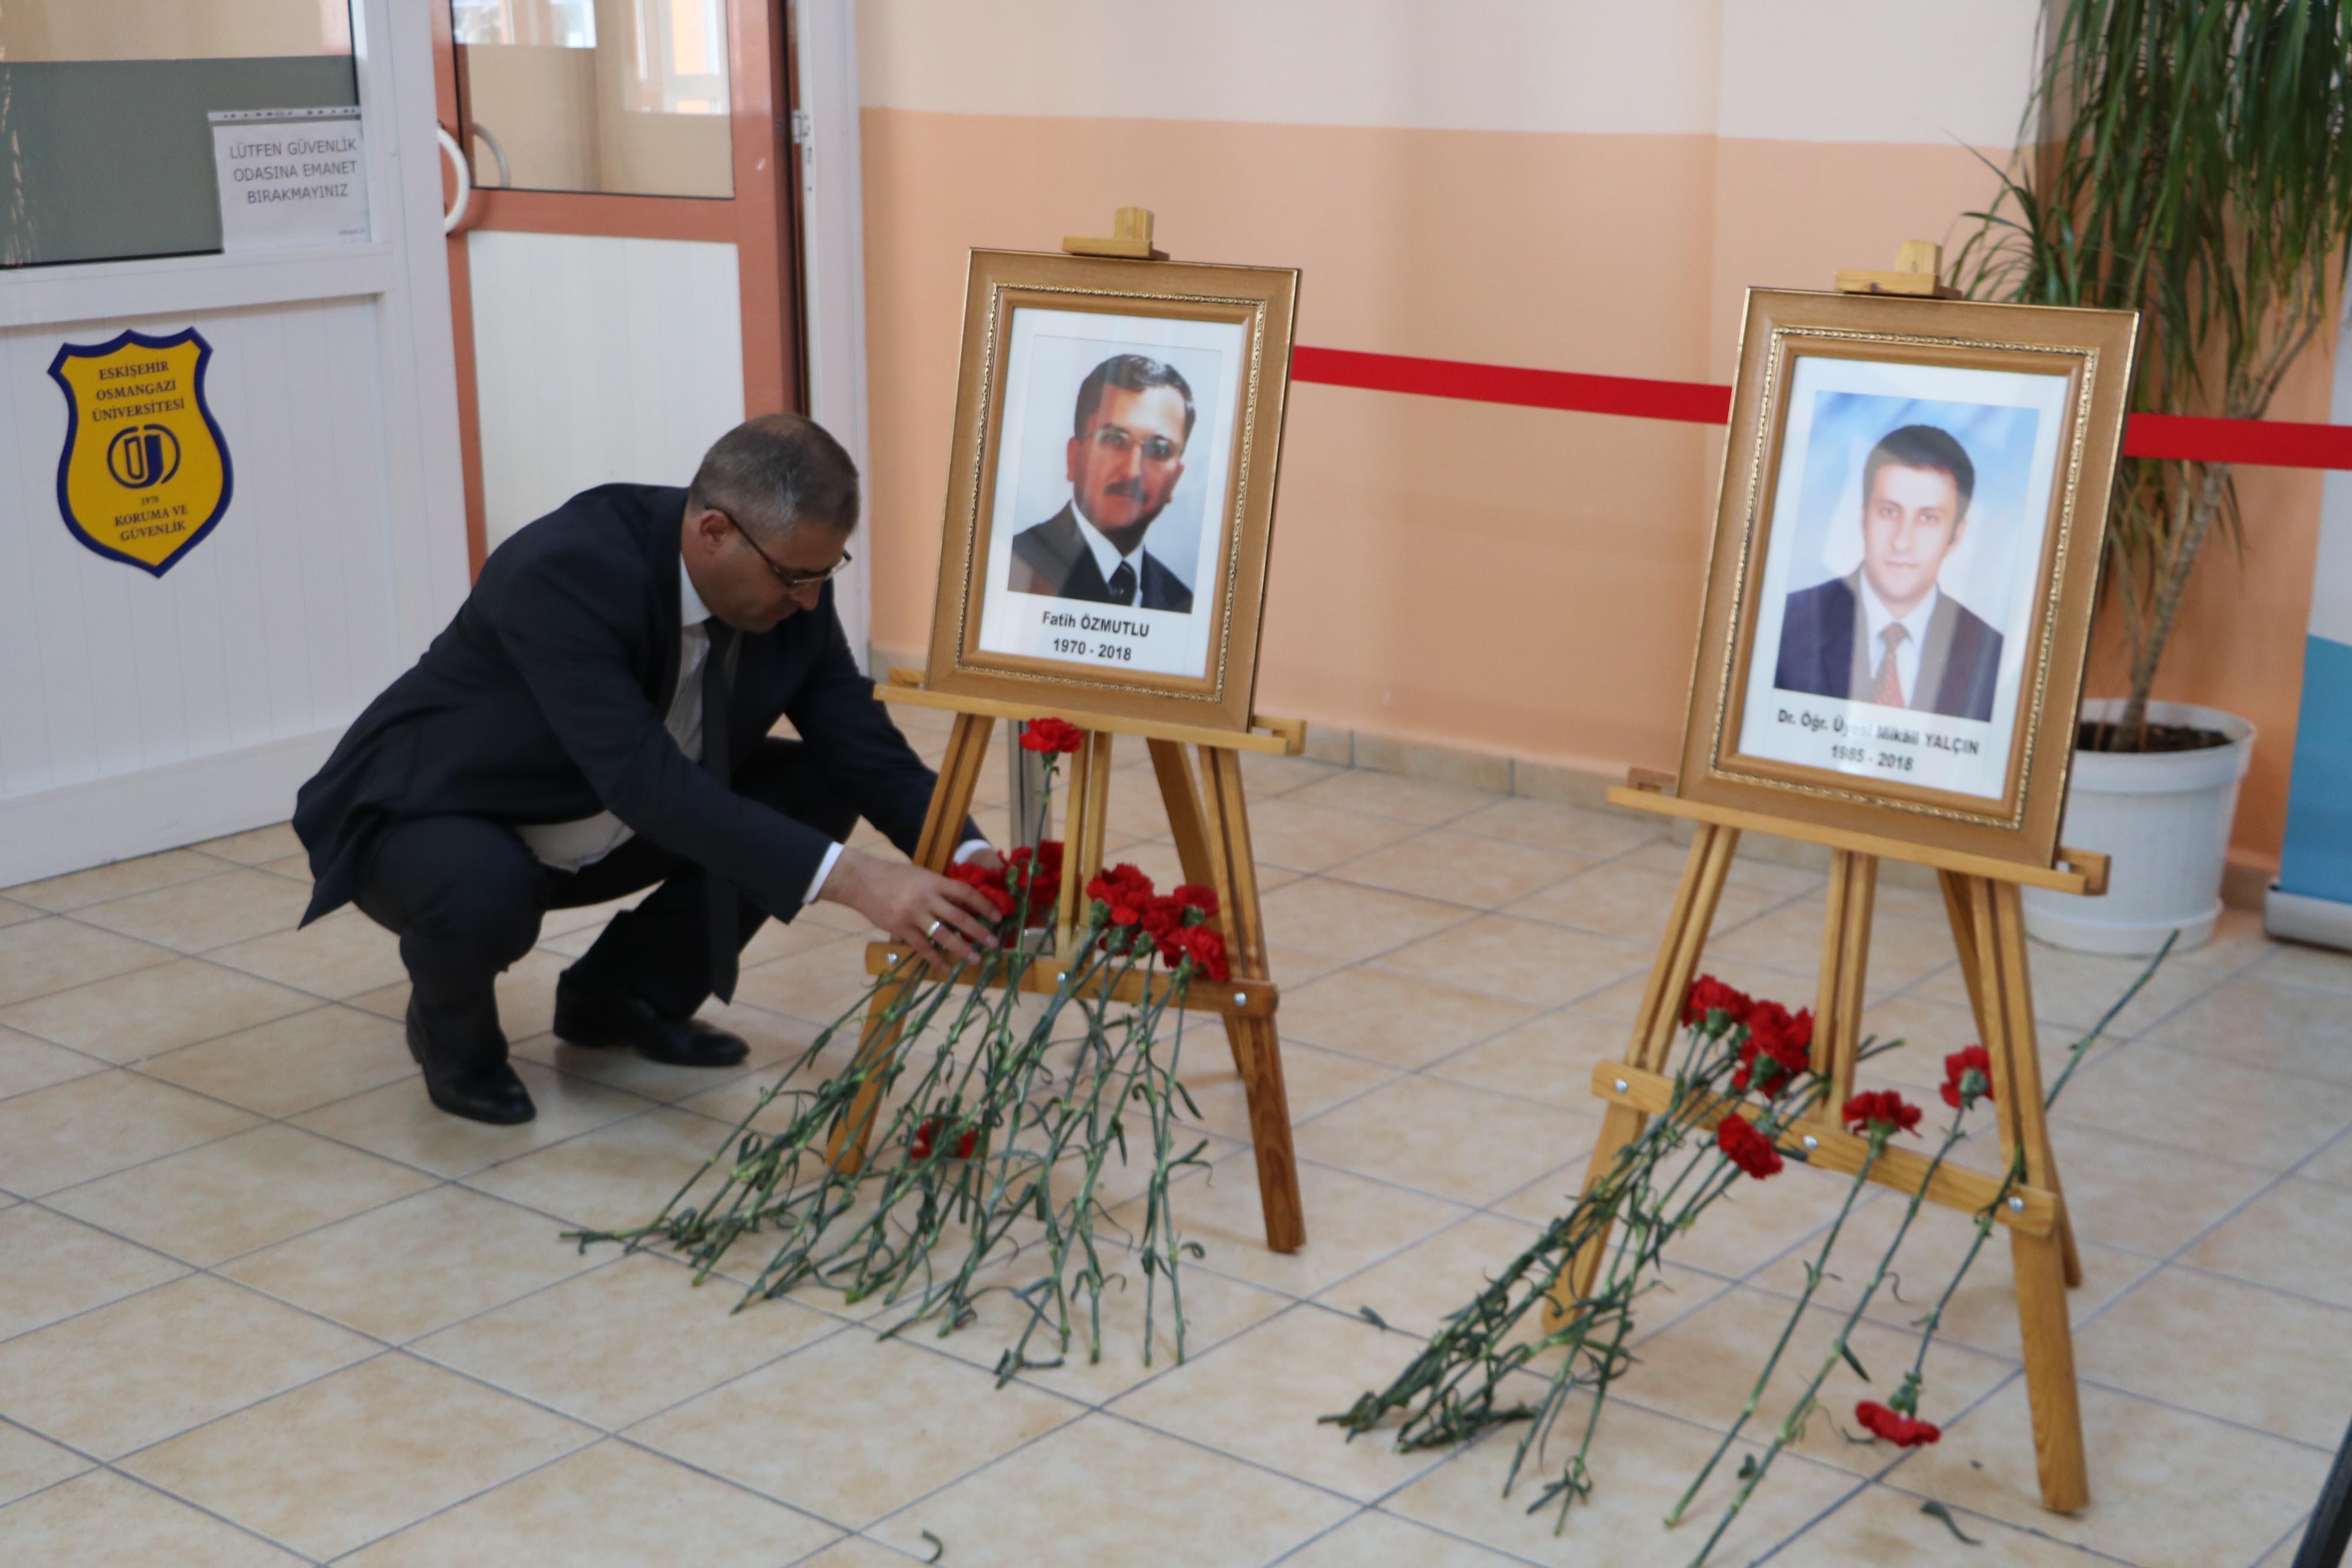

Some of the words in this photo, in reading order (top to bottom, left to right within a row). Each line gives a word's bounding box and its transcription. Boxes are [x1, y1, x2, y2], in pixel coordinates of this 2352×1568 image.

[230, 142, 282, 159] LÜTFEN
[288, 138, 357, 155] GÜVENLİK
[233, 165, 299, 182] ODASINA
[302, 160, 358, 177] EMANET
[247, 183, 349, 204] BIRAKMAYINIZ
[99, 361, 169, 380] ESKİŞEHİR
[96, 379, 176, 400] OSMANGAZİ
[93, 398, 185, 422] ÜNİVERSİTESİ
[141, 495, 159, 506] 1970
[114, 509, 169, 527] KORUMA
[172, 504, 188, 517] VE
[120, 520, 186, 541] GÜVENLİK
[1042, 610, 1076, 628] Fatih
[1081, 613, 1149, 637] ÖZMUTLU
[1053, 638, 1086, 655] 1970
[1099, 644, 1131, 661] 2018
[1778, 709, 1796, 725] Dr.
[1801, 710, 1828, 732] Öğr.
[1926, 733, 1979, 757] YALÇIN
[1877, 752, 1914, 771] 2018
